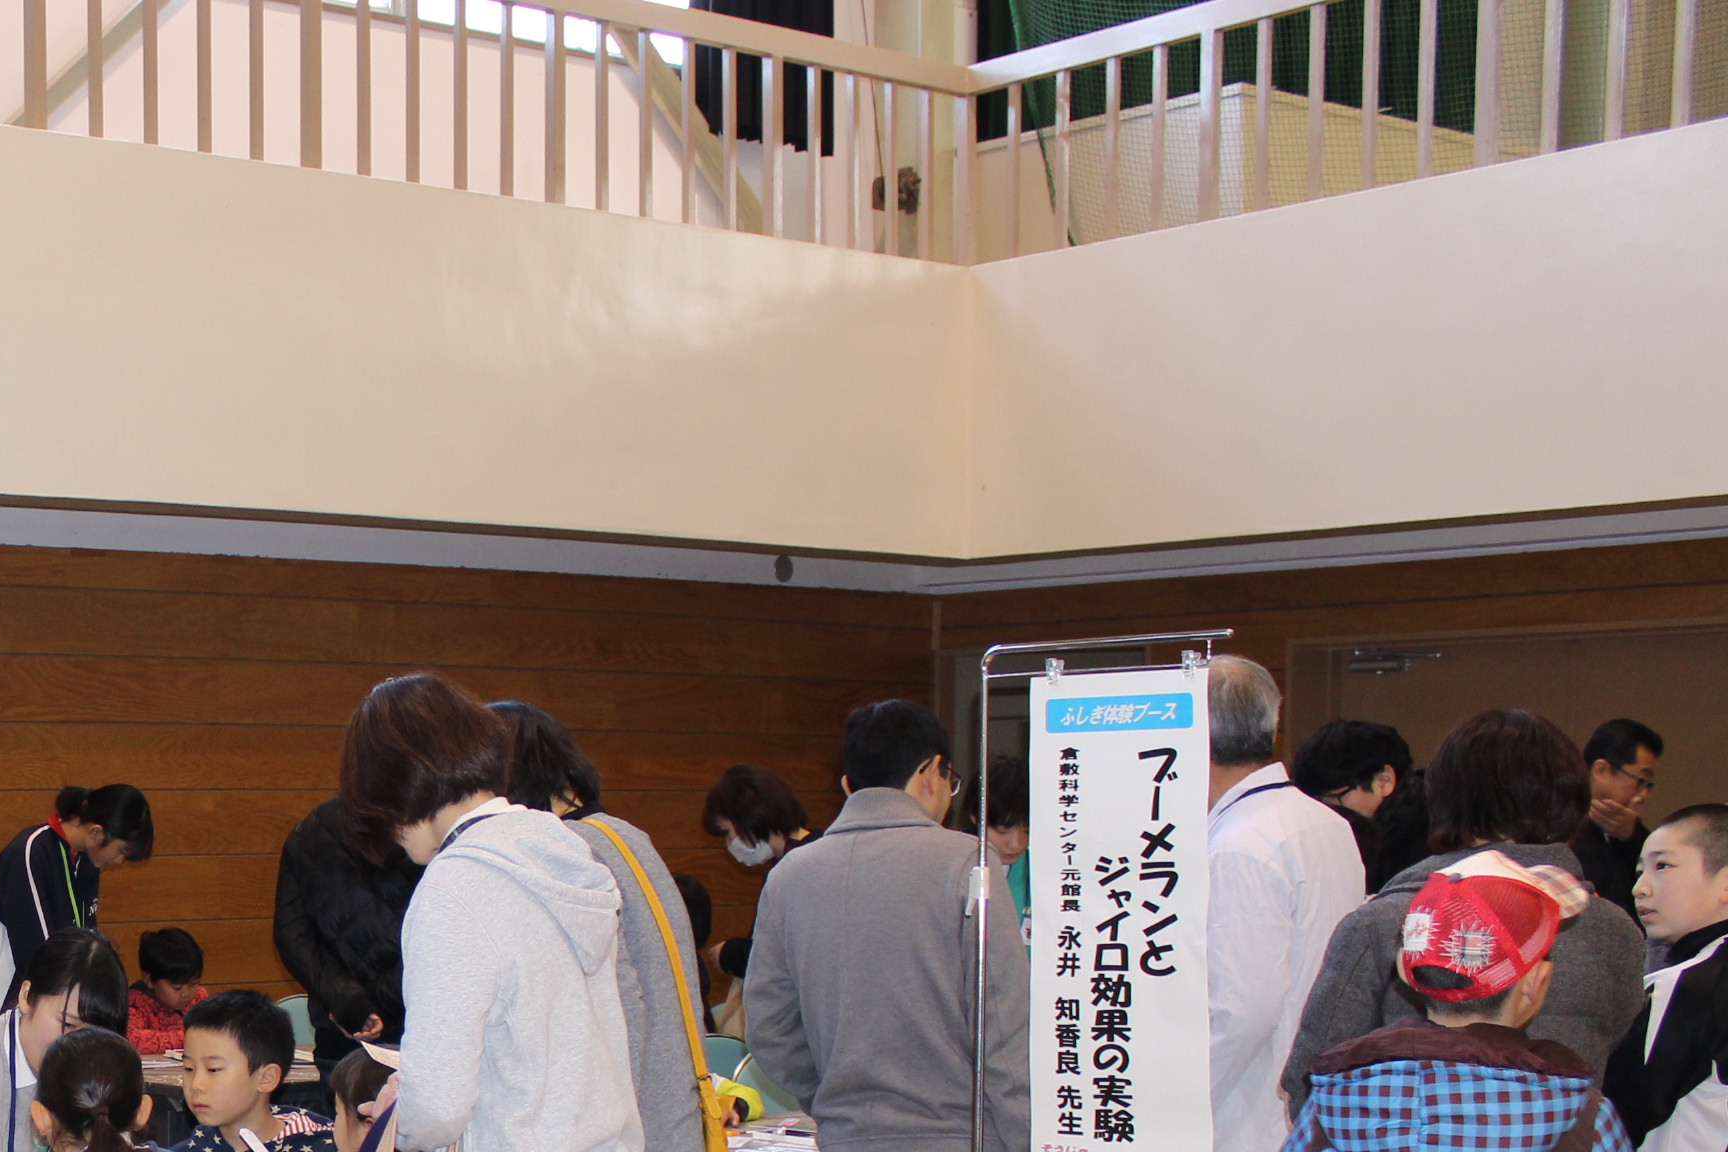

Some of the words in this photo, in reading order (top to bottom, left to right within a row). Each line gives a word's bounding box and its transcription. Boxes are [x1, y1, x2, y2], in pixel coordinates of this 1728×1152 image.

[1060, 701, 1178, 726] ふしぎ体験ブース
[1057, 747, 1082, 913] 倉敷科学センター元館長
[1137, 747, 1179, 977] ブーメランと
[1056, 926, 1083, 977] 永井
[1054, 997, 1082, 1076] 知香良
[1090, 856, 1135, 1143] ジャイロ効果の実験
[1056, 1085, 1084, 1136] 先生
